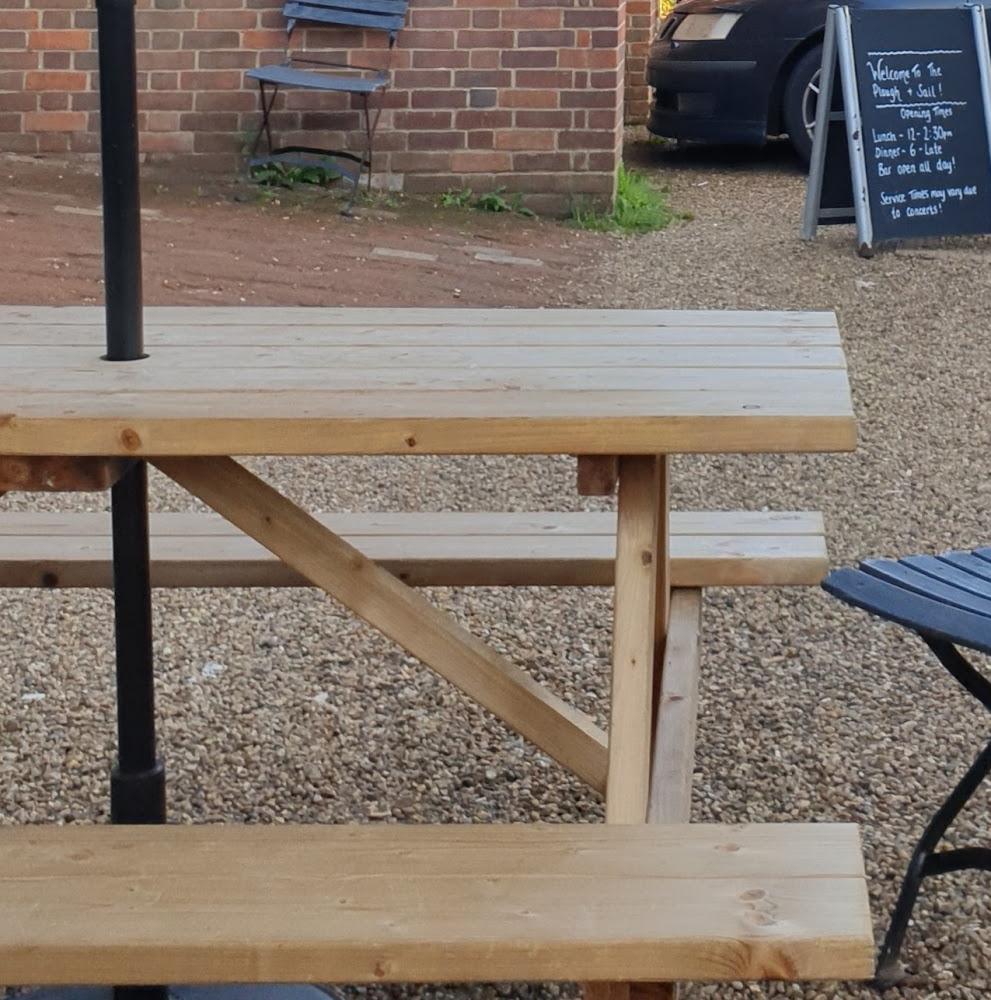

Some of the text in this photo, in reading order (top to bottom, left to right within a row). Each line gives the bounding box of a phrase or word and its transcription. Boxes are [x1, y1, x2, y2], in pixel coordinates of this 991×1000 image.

[866, 58, 942, 84] Welcome To The
[872, 83, 902, 103] Plough
[900, 106, 953, 123] Opening Times
[872, 128, 897, 143] Lunch
[909, 143, 916, 157] 6
[924, 142, 943, 156] Late
[878, 156, 956, 177] Bar open all day!
[908, 188, 929, 200] Times
[930, 189, 946, 202] may
[947, 187, 963, 200] vary
[963, 185, 978, 196] due
[891, 207, 901, 219] to
